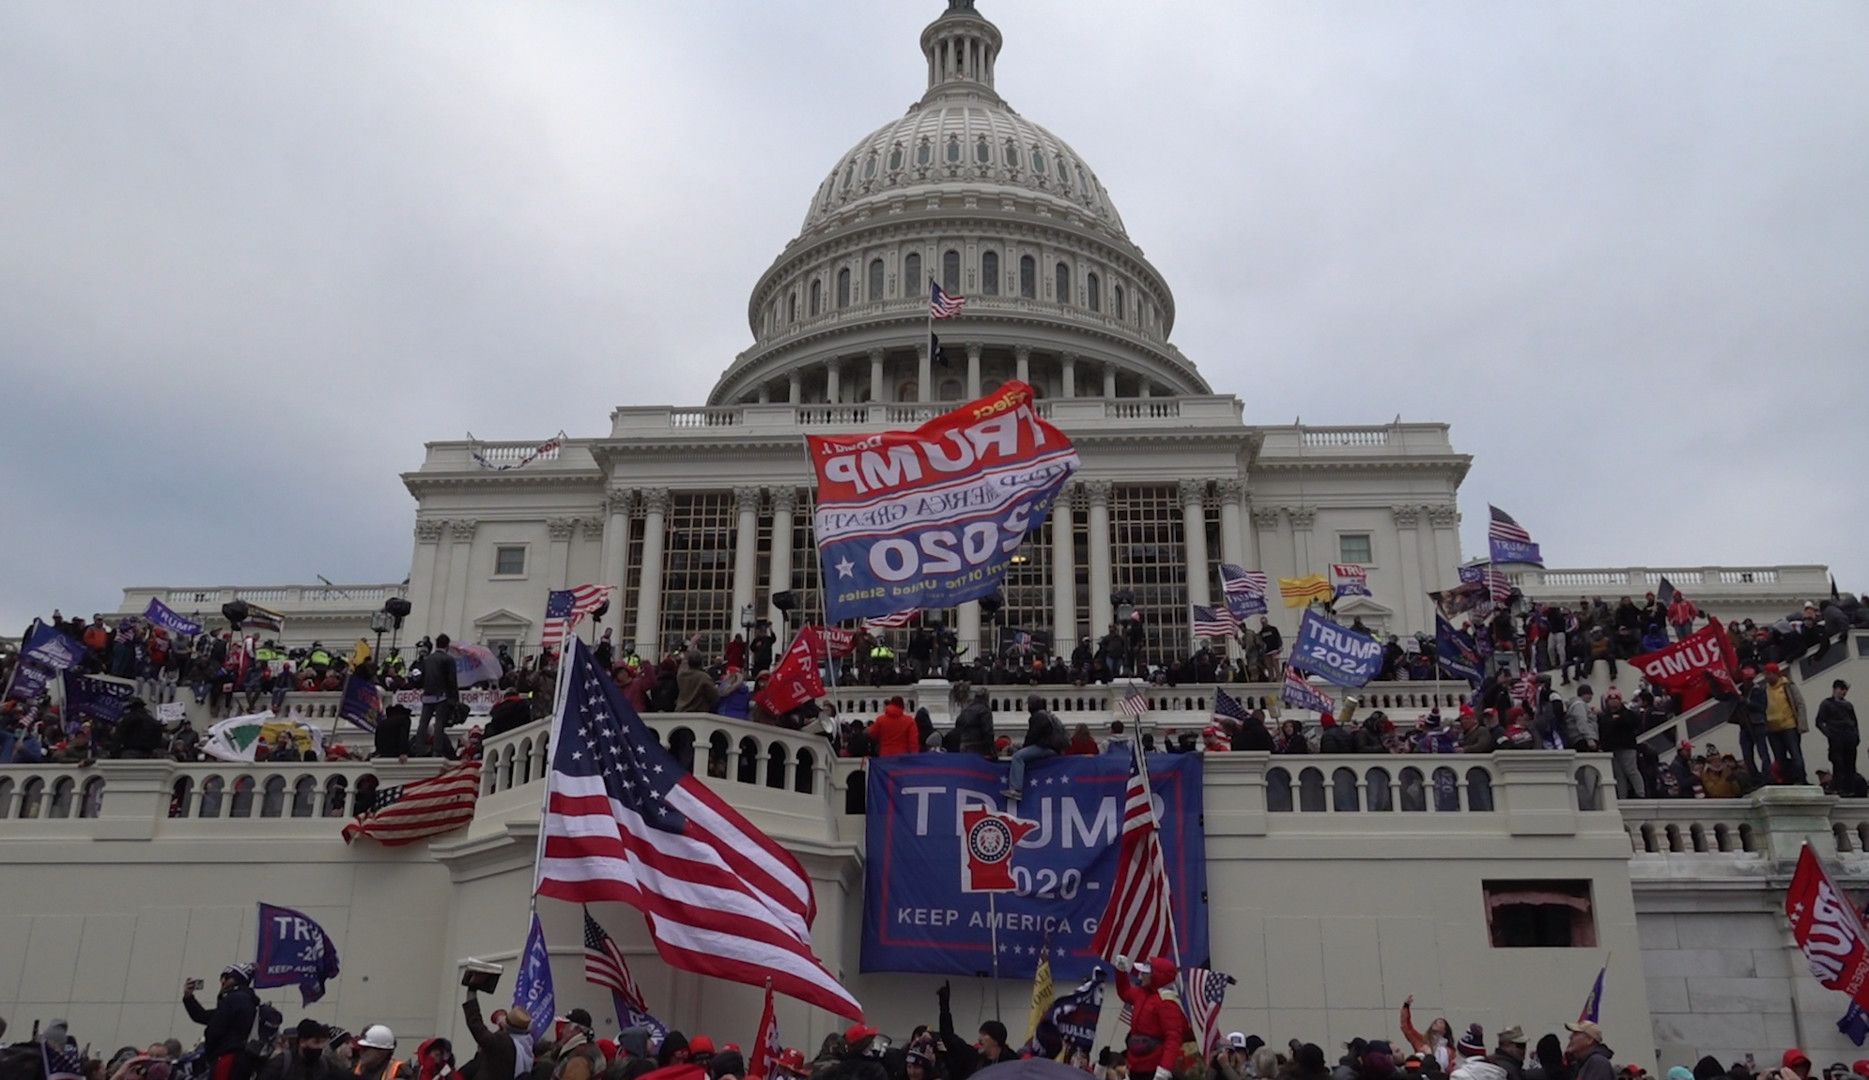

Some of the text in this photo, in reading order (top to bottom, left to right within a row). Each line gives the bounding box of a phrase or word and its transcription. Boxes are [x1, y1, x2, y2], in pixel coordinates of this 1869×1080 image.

[1340, 565, 1363, 576] TRU
[156, 605, 197, 631] TRUMP
[1308, 618, 1382, 659] TRUMP
[1310, 646, 1368, 675] 2024
[397, 692, 422, 703] GEOR
[901, 786, 1165, 850] TRUM
[898, 907, 959, 925] KEEP
[969, 913, 1072, 934] AMERICA
[268, 964, 293, 974] KEEP
